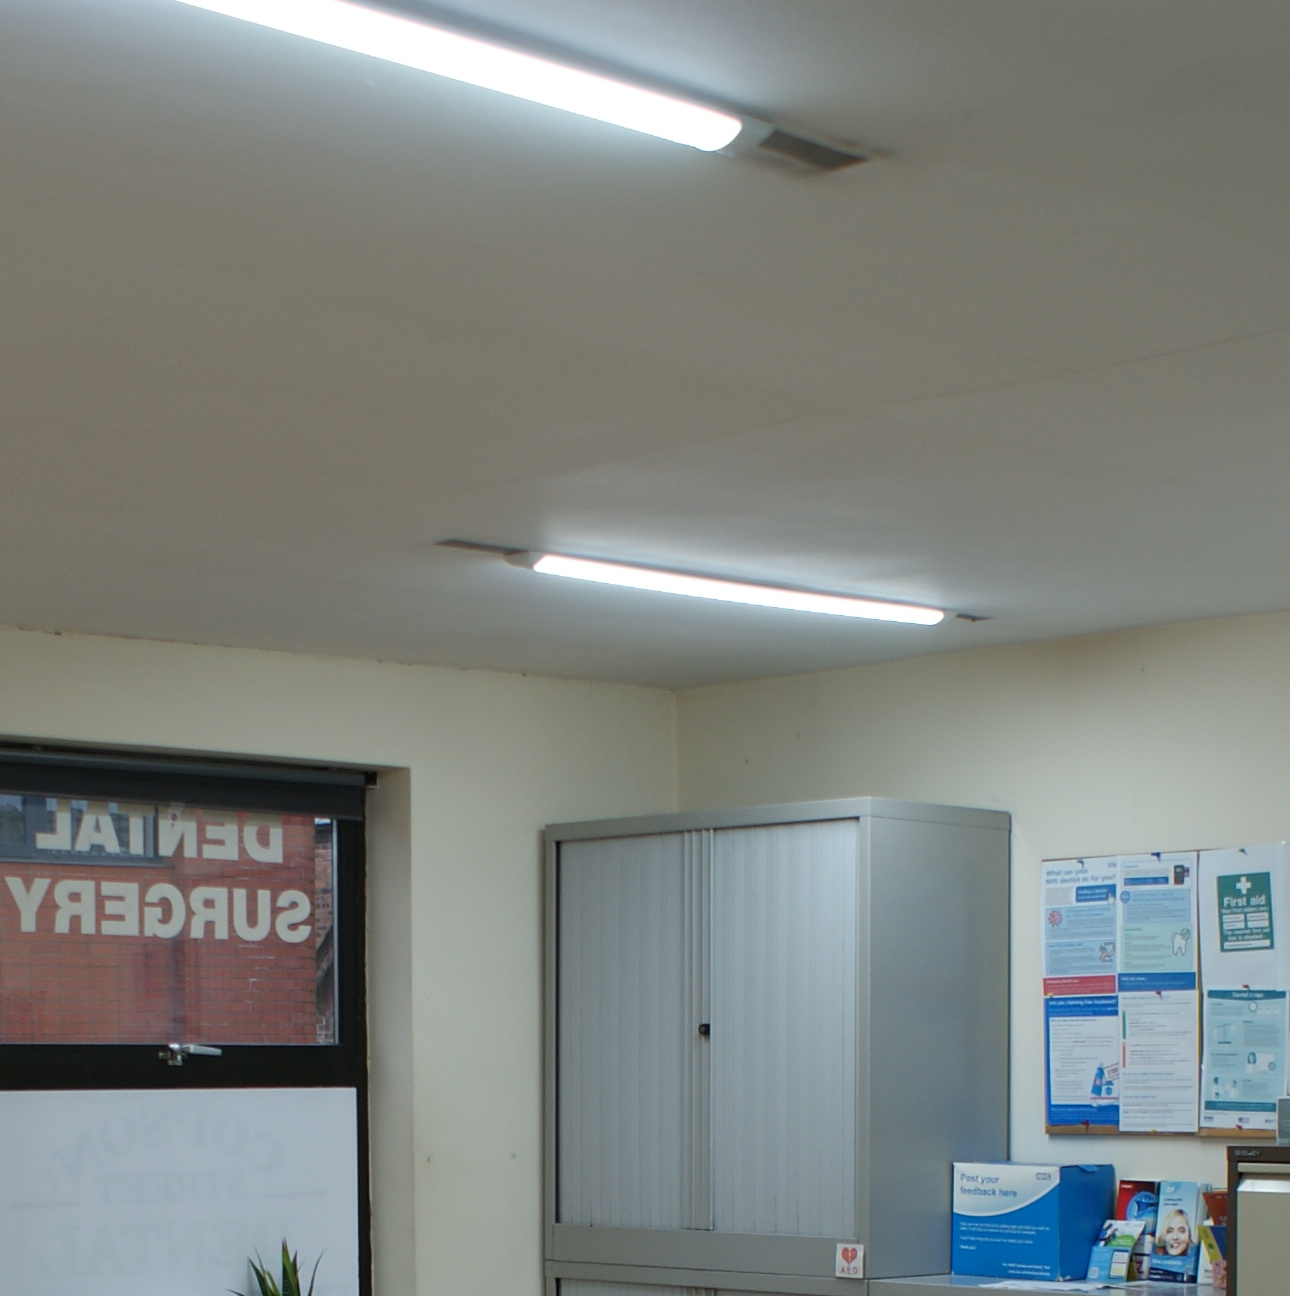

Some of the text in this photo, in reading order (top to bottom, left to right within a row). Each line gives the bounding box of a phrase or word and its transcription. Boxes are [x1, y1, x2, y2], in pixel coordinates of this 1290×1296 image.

[1224, 895, 1266, 907] First aid
[960, 1173, 979, 1182] Post
[980, 1176, 999, 1184] your
[960, 1186, 1017, 1197] feedback here
[840, 1266, 858, 1275] AED
